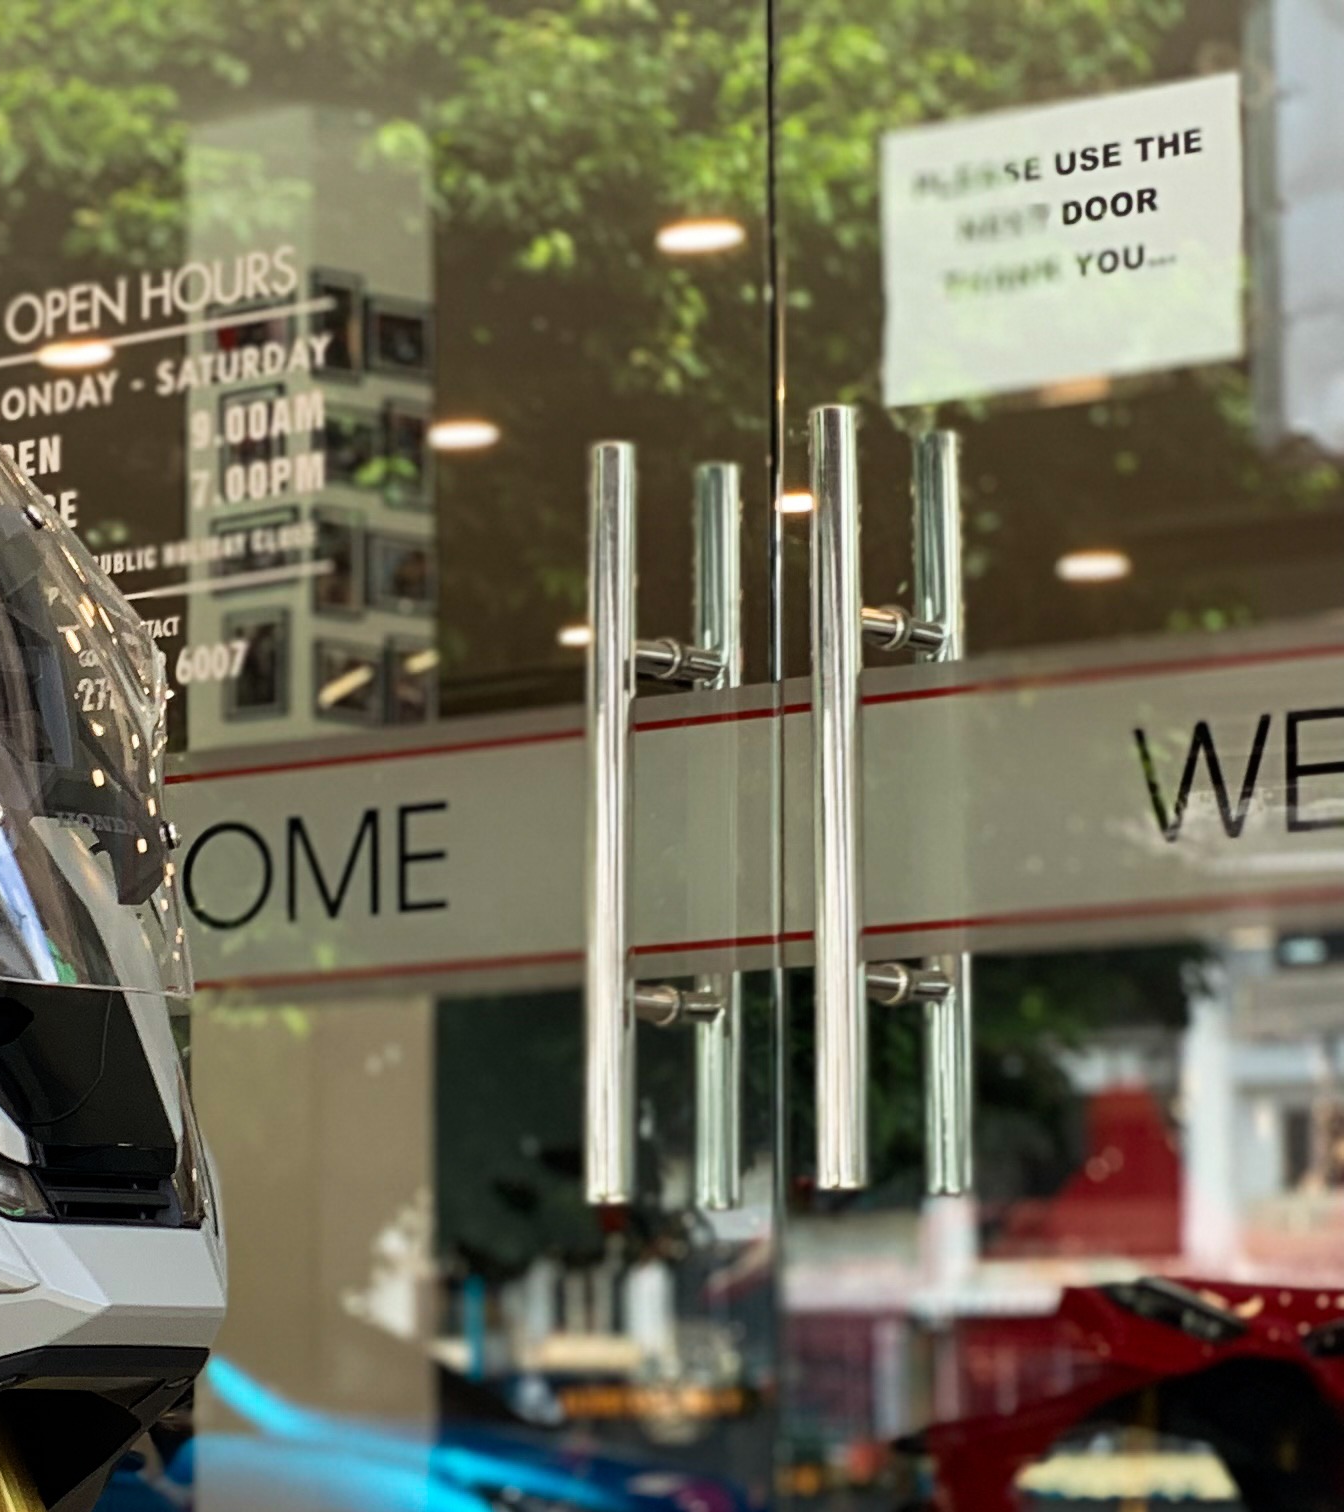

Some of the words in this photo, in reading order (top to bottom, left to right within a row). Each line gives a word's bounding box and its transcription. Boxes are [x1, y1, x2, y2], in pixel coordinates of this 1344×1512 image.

[1054, 141, 1122, 176] USE
[1135, 128, 1203, 162] THE
[1061, 187, 1158, 226] DOOR
[3, 276, 127, 344] OPEN
[140, 246, 298, 320] HOURS
[156, 335, 333, 396] SATURDAY
[191, 390, 325, 451] 9.00AM
[191, 452, 326, 510] 7.00PM
[175, 640, 250, 685] 6007
